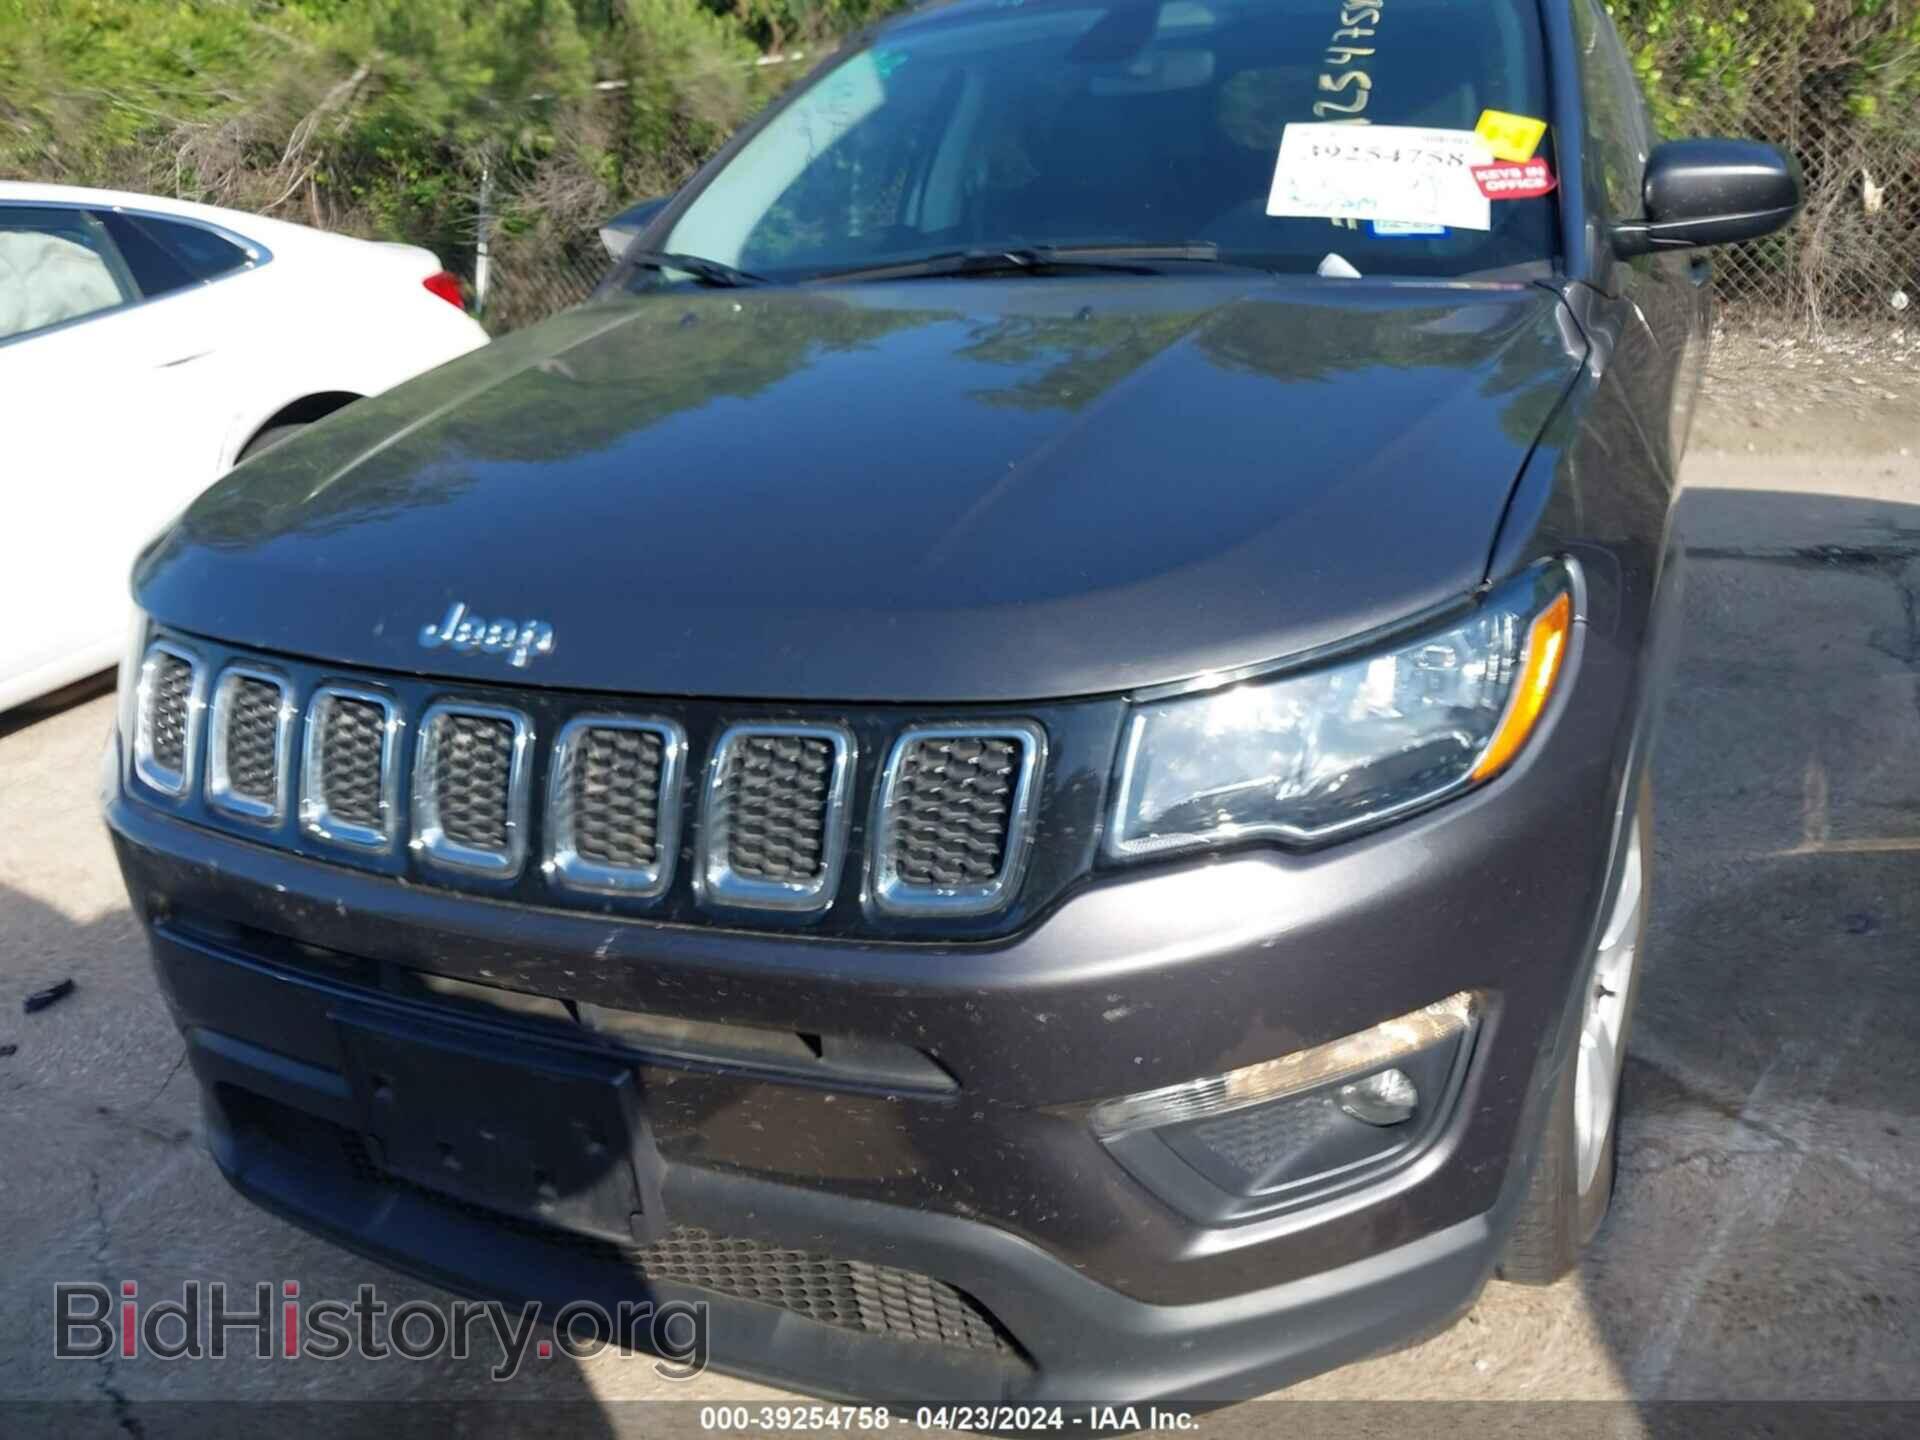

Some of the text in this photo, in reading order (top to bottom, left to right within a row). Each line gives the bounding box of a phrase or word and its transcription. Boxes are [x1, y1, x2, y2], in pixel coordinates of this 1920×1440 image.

[1475, 166, 1546, 181] KEYS IN
[1485, 178, 1547, 192] OFFICE
[418, 602, 554, 667] Jeep
